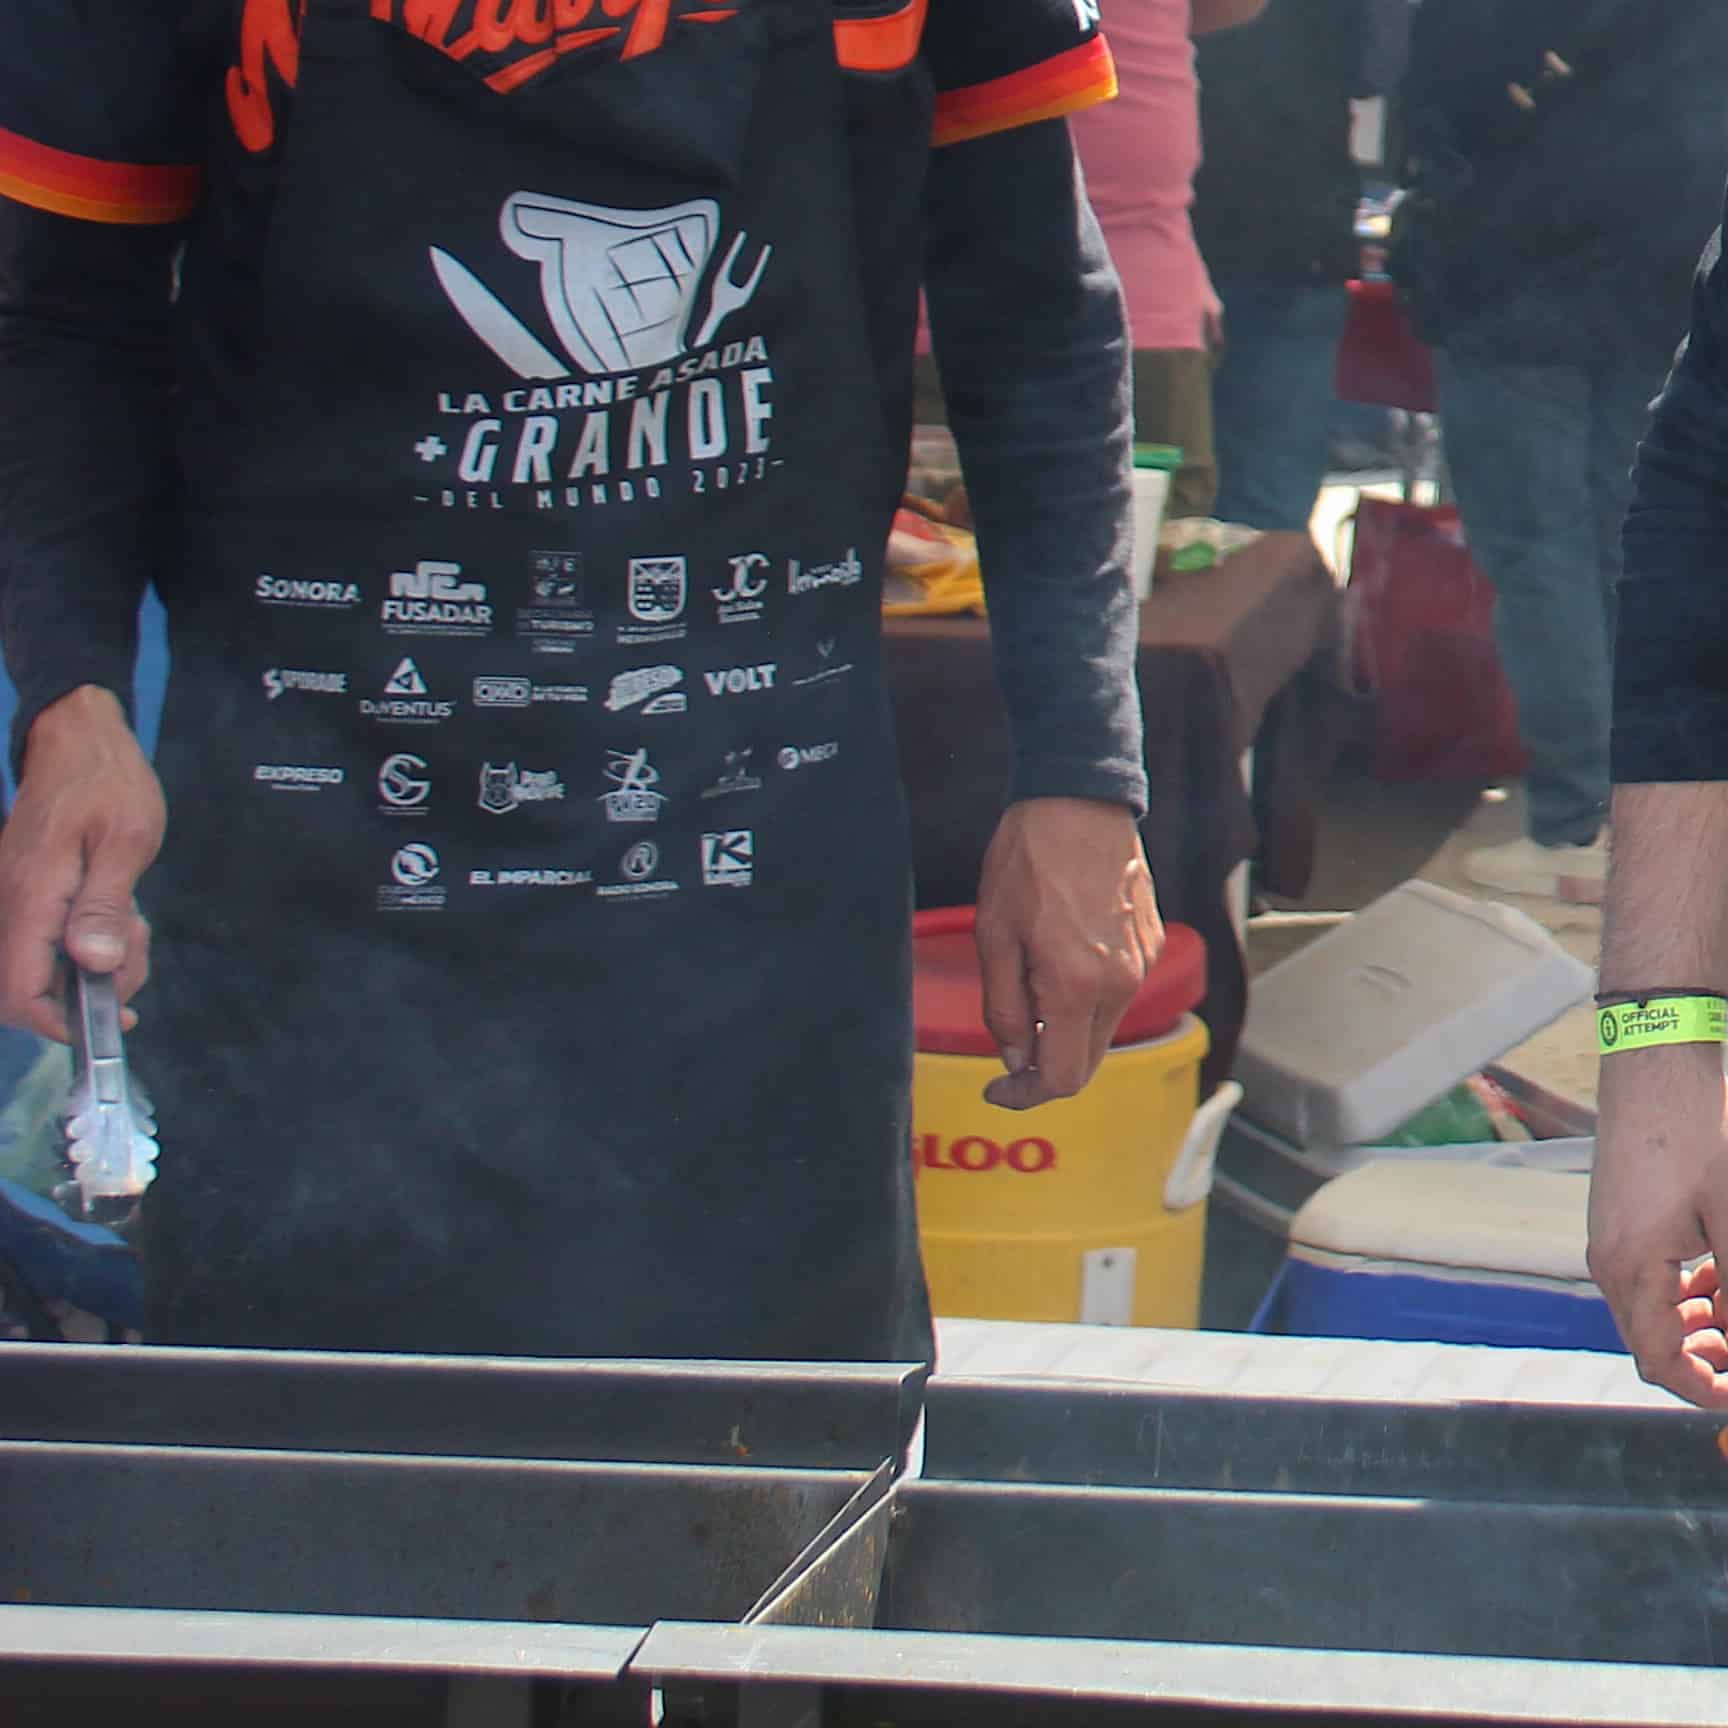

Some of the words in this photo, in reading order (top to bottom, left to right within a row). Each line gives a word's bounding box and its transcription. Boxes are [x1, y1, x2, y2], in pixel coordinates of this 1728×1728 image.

[438, 392, 491, 413] LA
[503, 376, 639, 412] CARNE
[648, 335, 769, 391] ASADA
[536, 477, 661, 508] MUNDO
[381, 600, 493, 624] FUSADAR
[703, 663, 776, 696] VOLT
[1622, 1007, 1679, 1022] OFFICIAL
[1624, 1020, 1678, 1036] ATTEMPT
